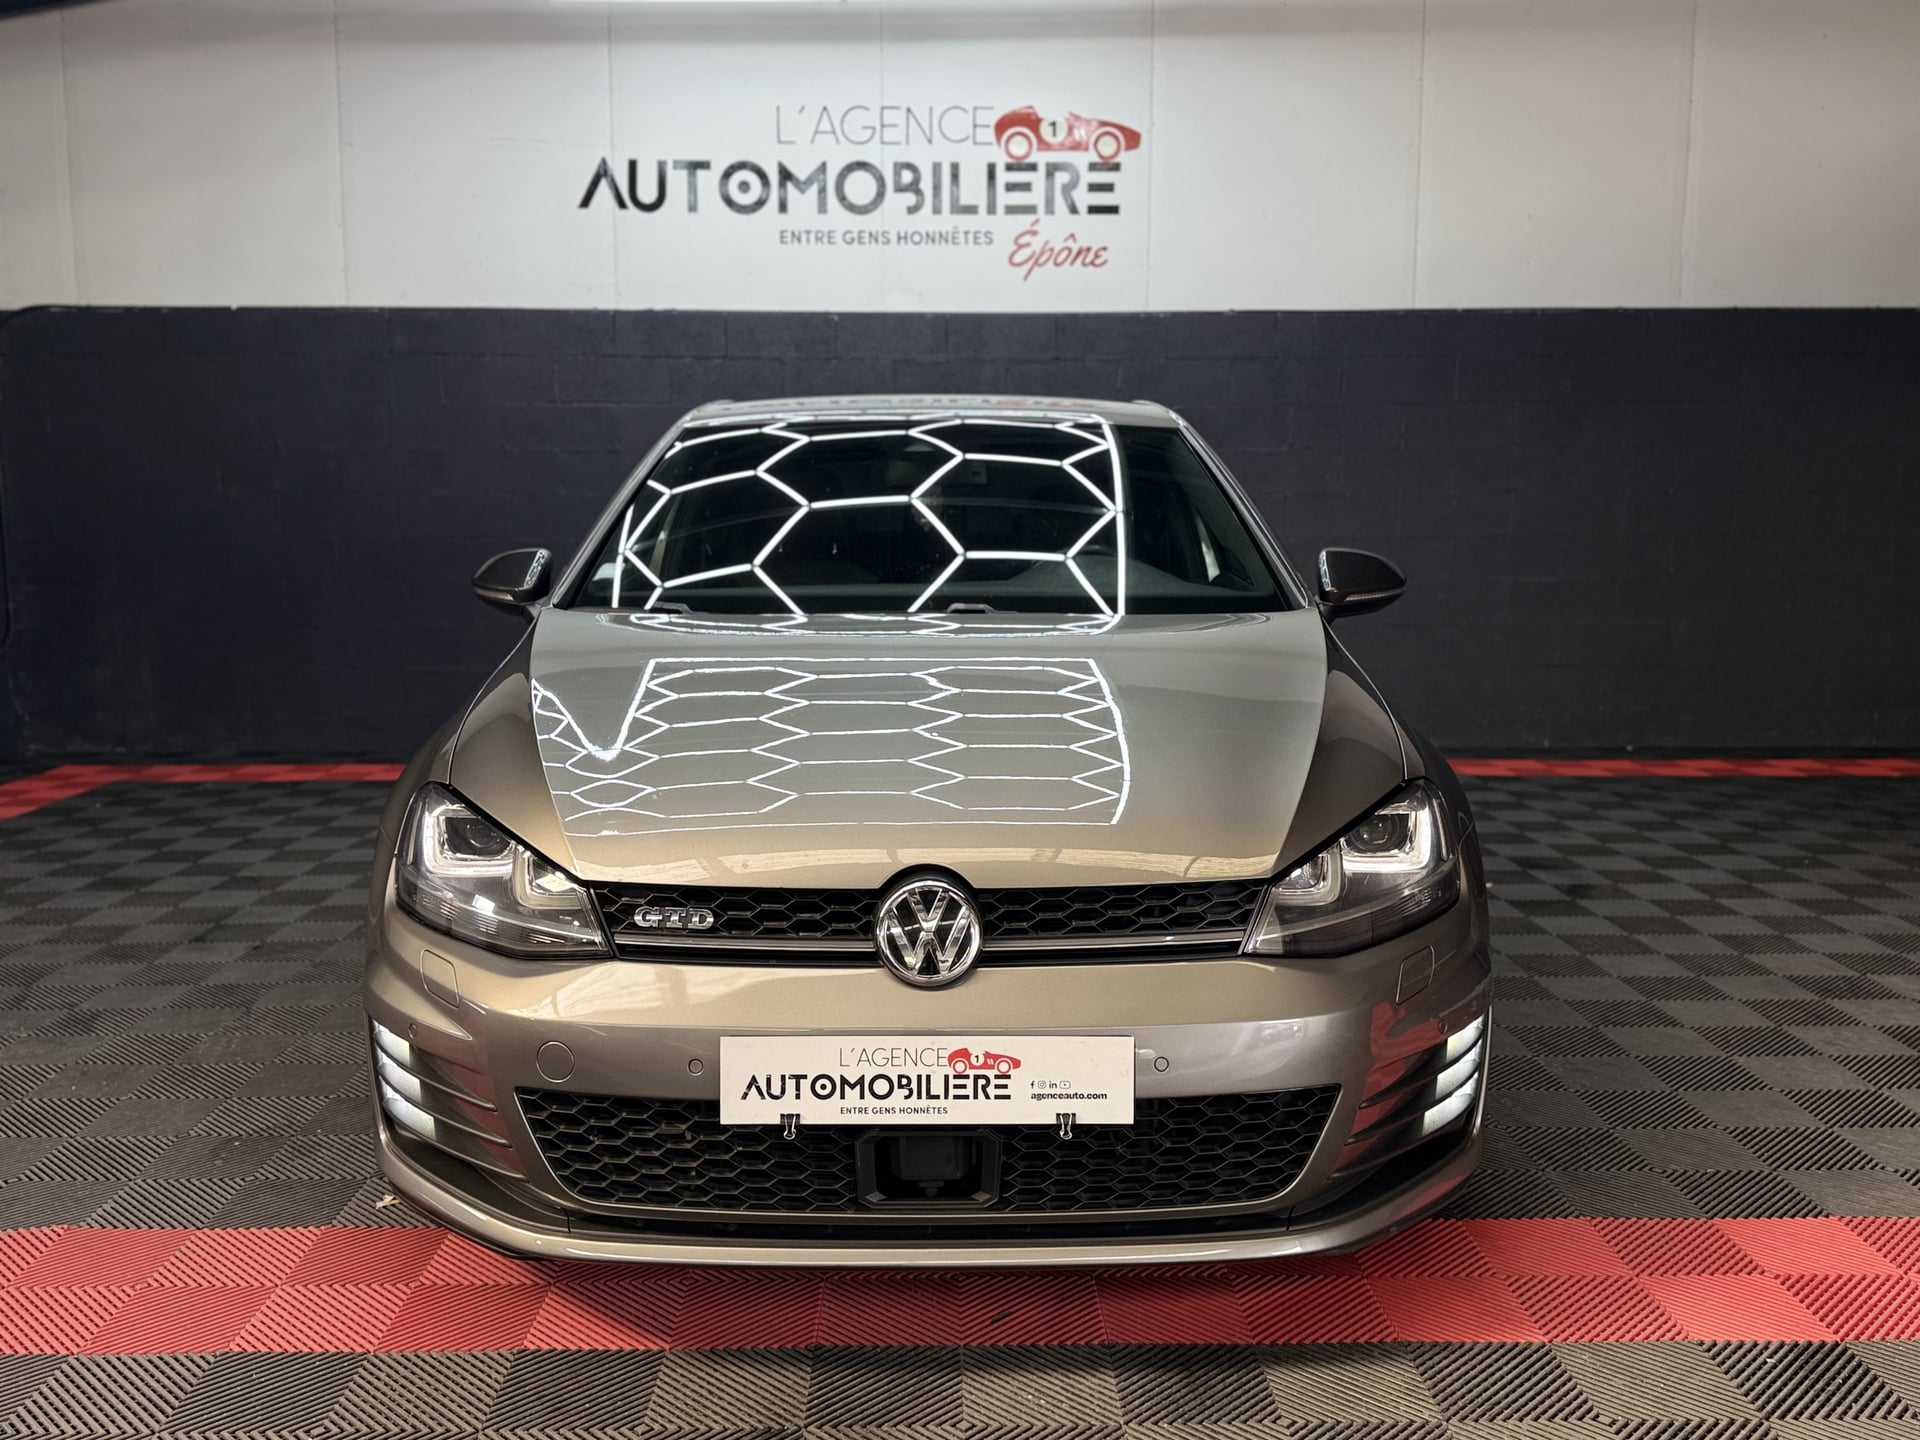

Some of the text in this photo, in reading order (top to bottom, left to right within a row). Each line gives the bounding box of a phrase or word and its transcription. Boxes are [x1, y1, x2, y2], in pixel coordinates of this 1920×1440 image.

[775, 105, 995, 146] L'AGENCE
[1047, 120, 1058, 138] 1
[779, 226, 994, 246] ENTRE GENS HONNÊTES
[1006, 218, 1109, 281] Épône
[633, 906, 715, 930] GTD
[839, 1047, 949, 1067] L'AGENCE
[1030, 1092, 1108, 1101] agenceauto.com
[840, 1104, 949, 1115] ENTRE GENS HONNÊTES
